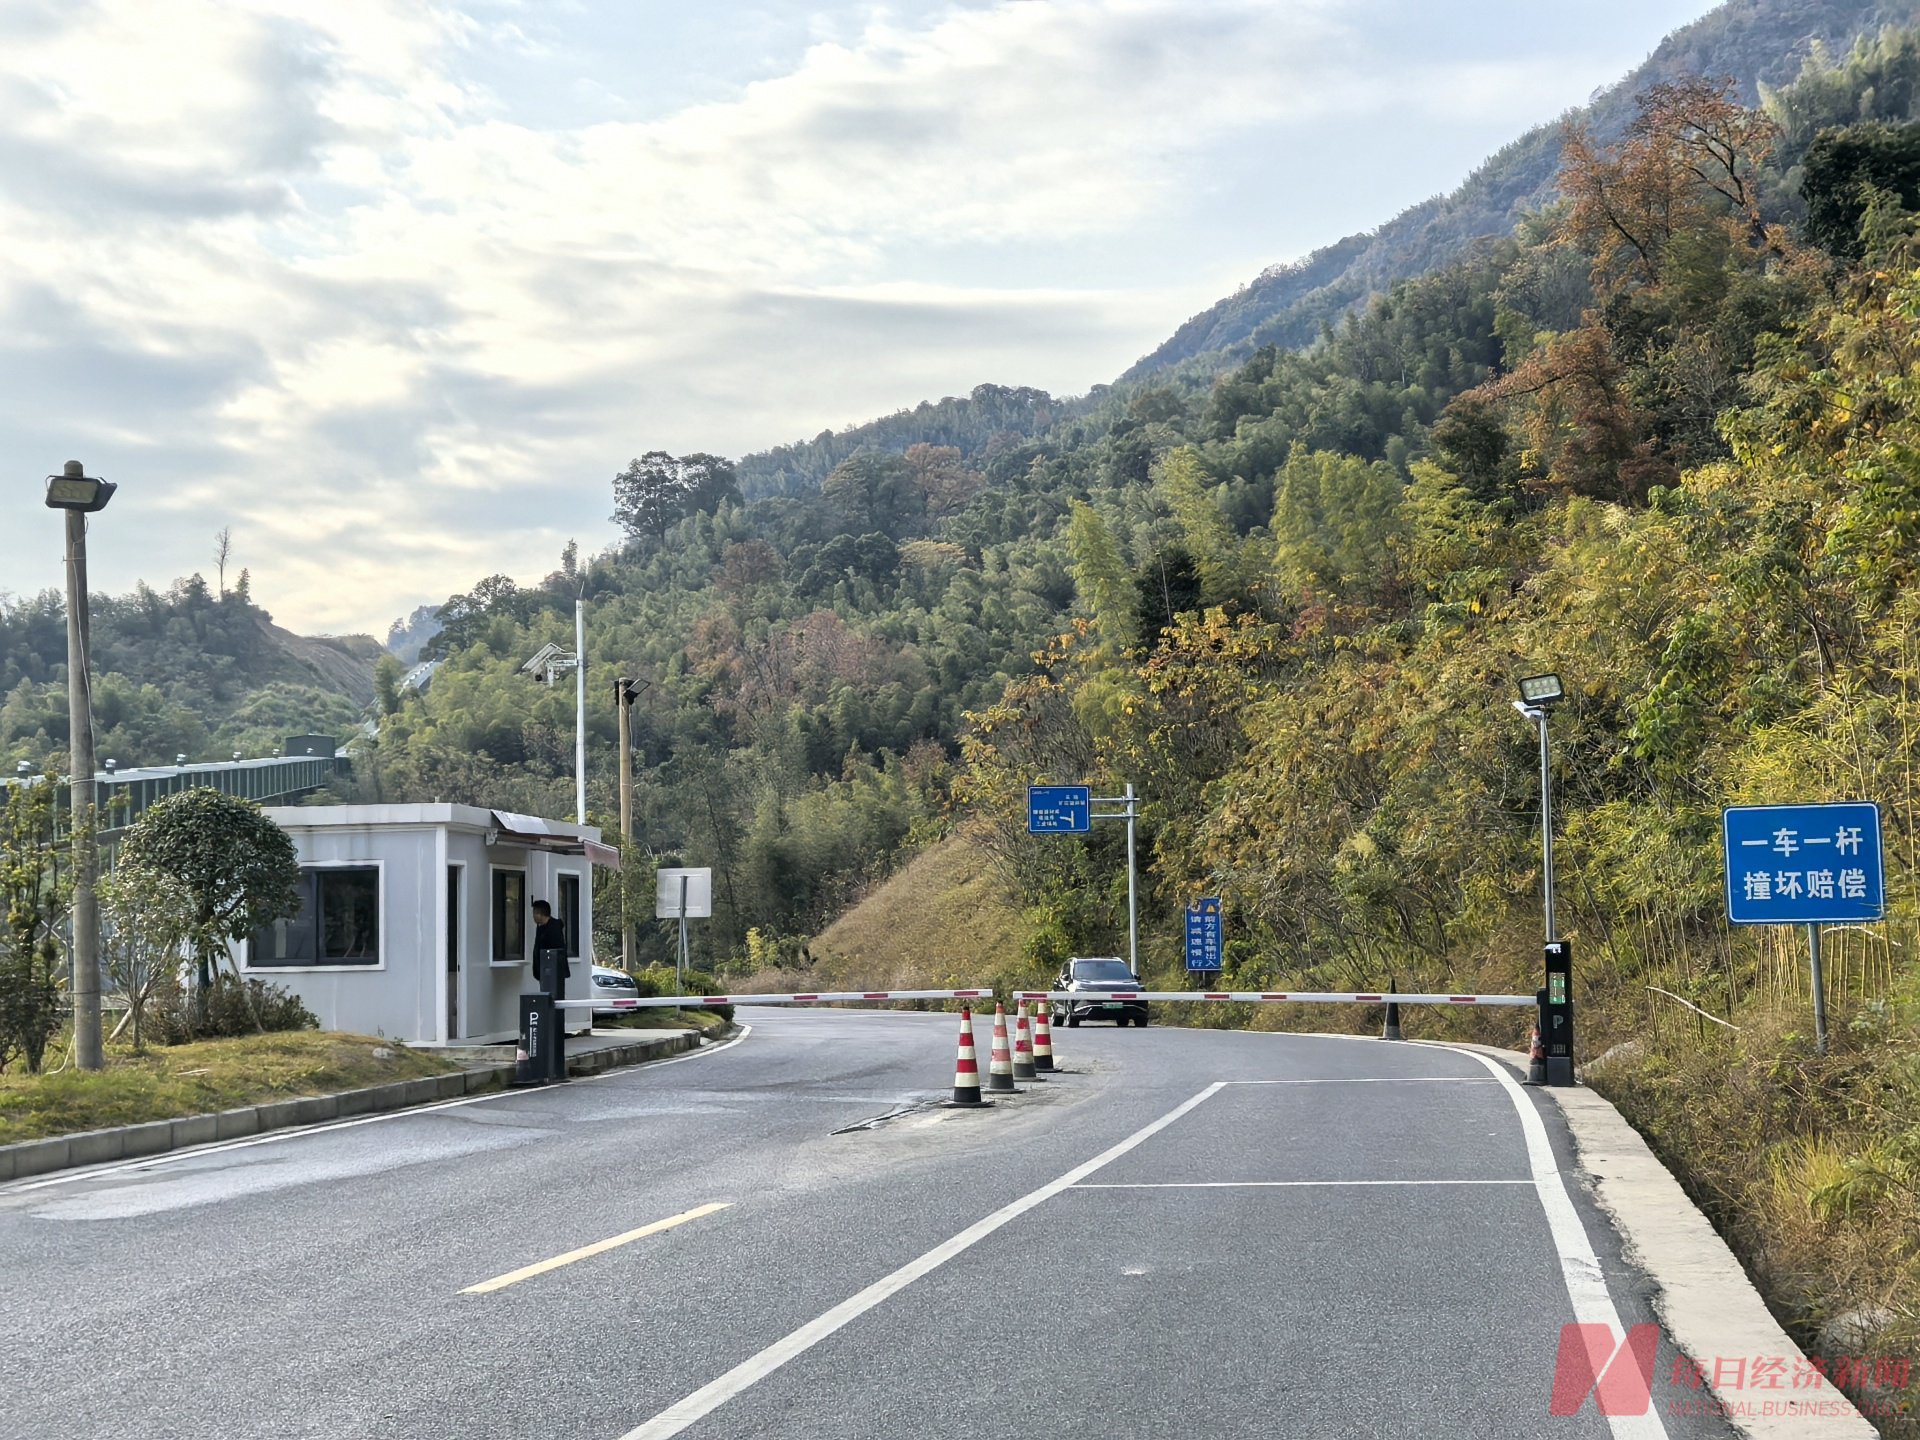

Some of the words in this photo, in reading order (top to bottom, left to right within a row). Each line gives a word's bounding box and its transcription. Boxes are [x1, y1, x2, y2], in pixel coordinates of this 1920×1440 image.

[1741, 826, 1863, 857] 一车一杆
[1743, 868, 1867, 900] 撞坏赔偿
[1190, 915, 1203, 967] 请减速慢行
[1204, 915, 1218, 967] 前方有车辆出入
[1552, 1014, 1564, 1029] P
